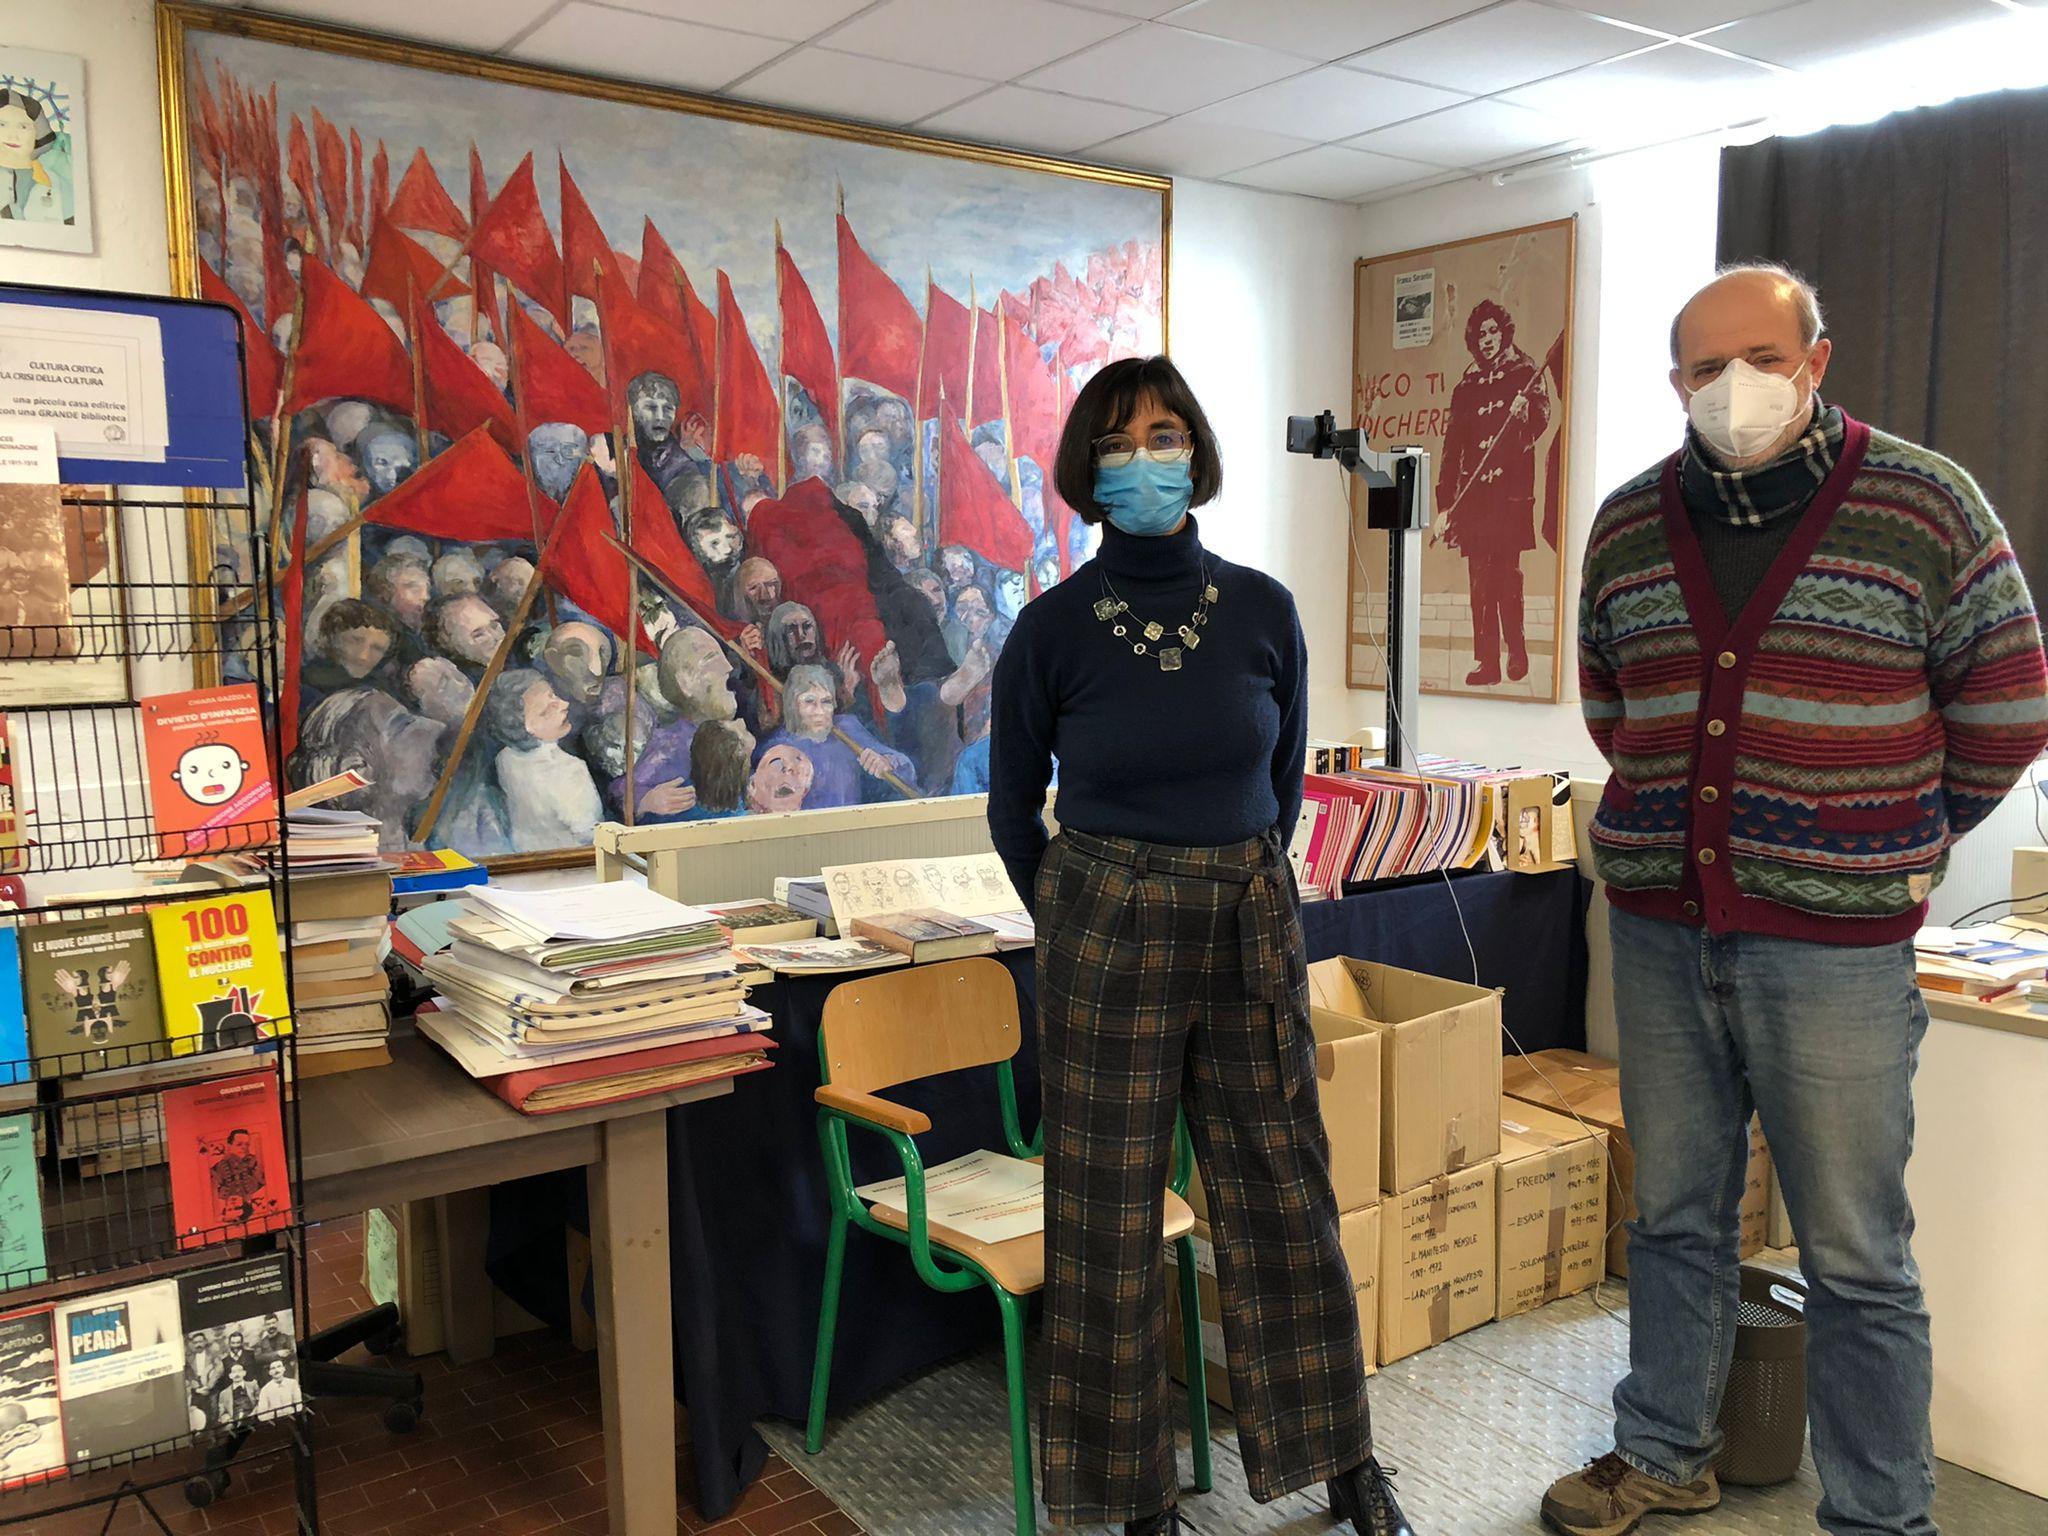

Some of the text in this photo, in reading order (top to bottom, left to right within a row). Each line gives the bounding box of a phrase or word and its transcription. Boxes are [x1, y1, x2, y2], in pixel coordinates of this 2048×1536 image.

[29, 361, 104, 375] CULTURA CRITICA
[13, 372, 34, 381] CRISI
[36, 374, 62, 383] DELLA
[63, 376, 104, 386] CULTURA
[1425, 372, 1445, 394] TI
[13, 397, 126, 411] una piccola casa editrice
[18, 409, 36, 417] una
[38, 409, 79, 419] GRANDE
[81, 412, 127, 422] biblioteca
[156, 707, 257, 726] DIVIETO D'INFANZIA
[182, 904, 249, 943] 100
[33, 941, 44, 953] LE
[45, 937, 76, 951] NUOVE
[77, 932, 114, 947] CAMICIE
[115, 928, 145, 941] BRUNE
[187, 944, 252, 967] CONTRO
[188, 957, 255, 979] IL NUCLEARE
[1516, 1171, 1556, 1188] FREEDOM
[1411, 1212, 1431, 1226] LINEA
[1418, 1242, 1450, 1260] MANIFESTO
[1453, 1234, 1478, 1249] MENSILE
[72, 1319, 128, 1356] PEARÀ
